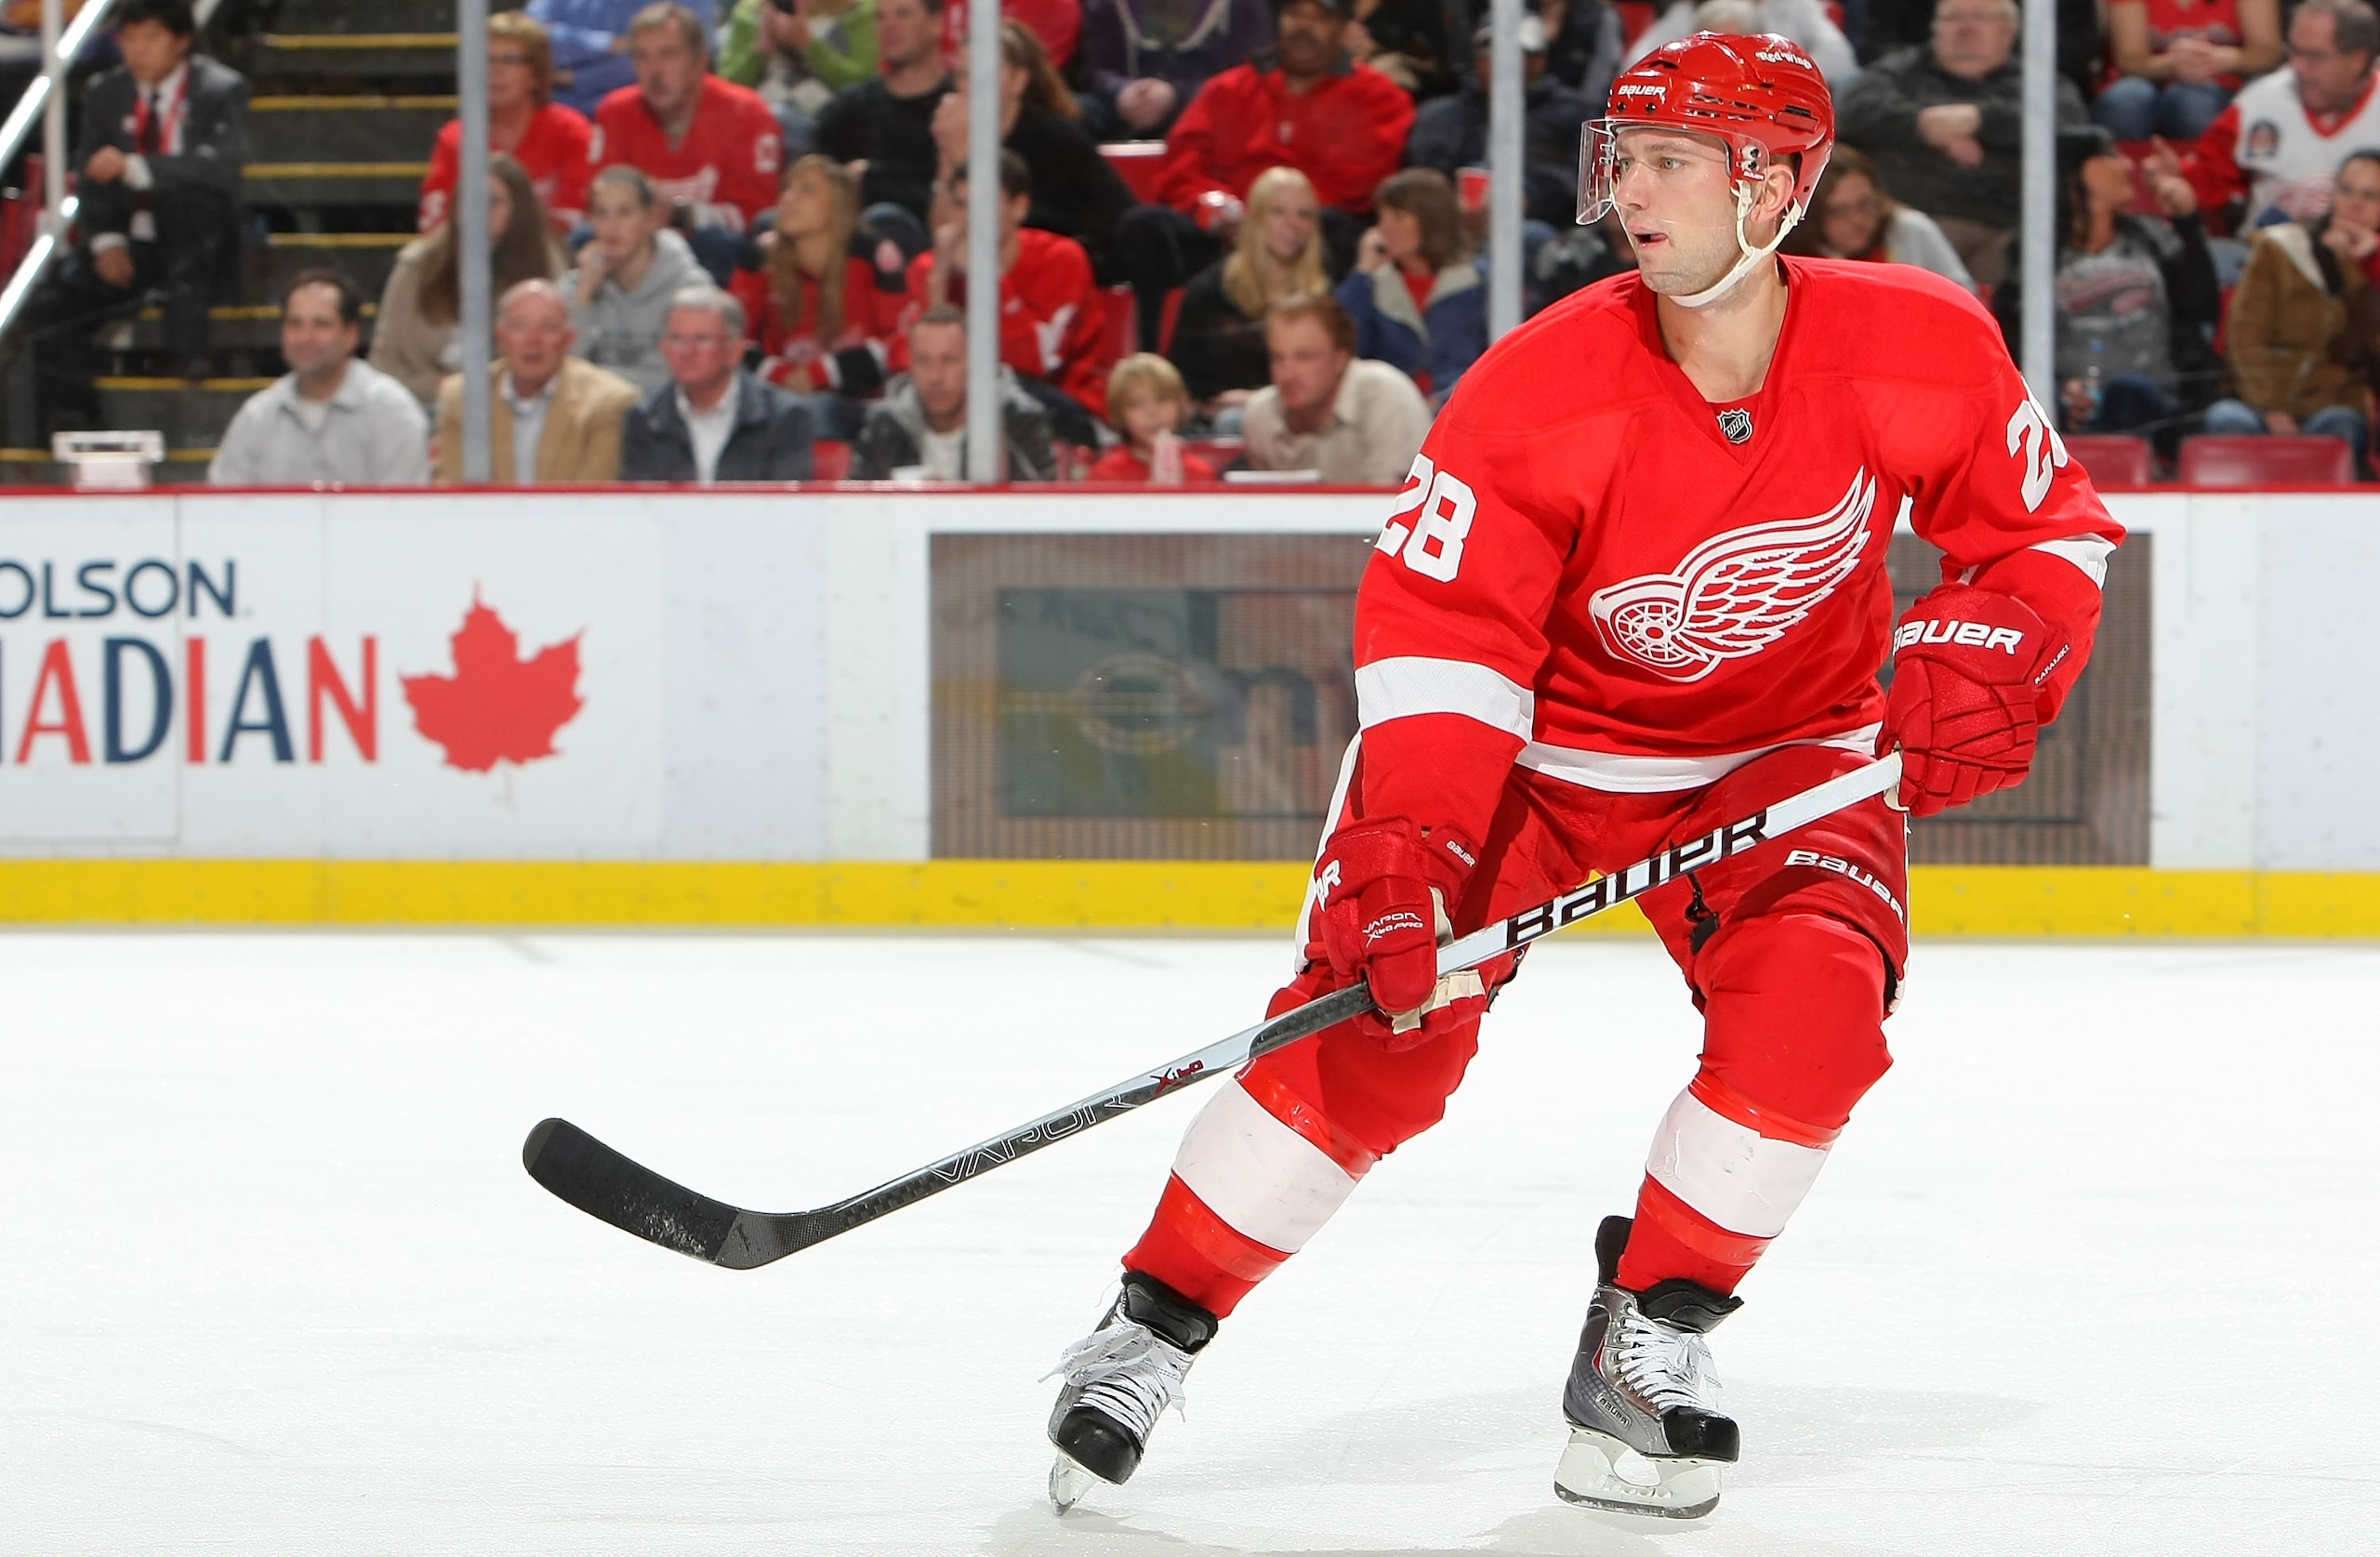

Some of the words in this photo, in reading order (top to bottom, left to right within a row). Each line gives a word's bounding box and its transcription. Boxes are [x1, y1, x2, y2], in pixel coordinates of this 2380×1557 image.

[1618, 85, 1667, 96] BAUER
[1374, 452, 1479, 584] 28
[1446, 839, 1476, 867] BAUER
[1506, 808, 1766, 950] BAUER
[1783, 850, 1904, 925] BAUER
[1362, 912, 1422, 933] VAPOR
[930, 1092, 1139, 1184] VAPOR
